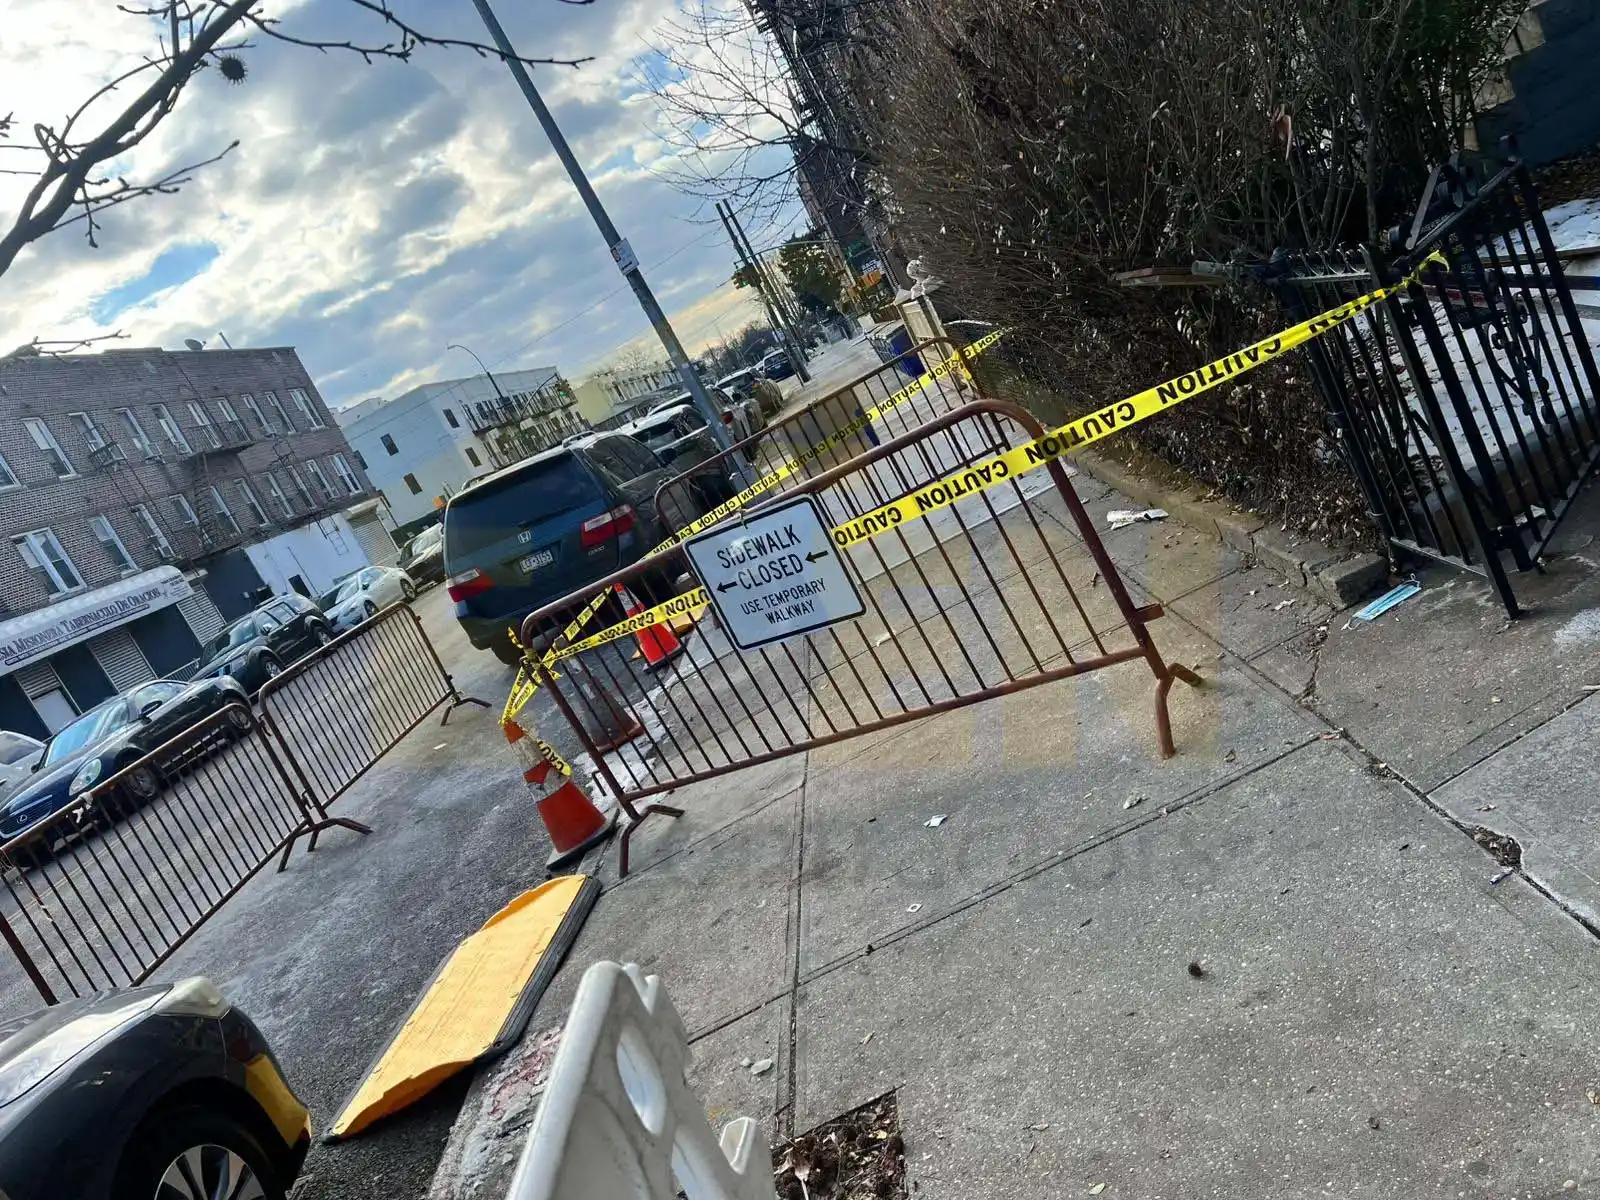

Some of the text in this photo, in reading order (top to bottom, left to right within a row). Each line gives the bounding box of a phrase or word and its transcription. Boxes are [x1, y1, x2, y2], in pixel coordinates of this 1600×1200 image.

[1024, 402, 1136, 465] CAUTION
[914, 459, 1010, 512] CAUTION
[717, 524, 801, 569] SIDEWALK
[738, 553, 804, 590] CLOSED
[741, 578, 826, 616] USE TEMPORARY
[765, 600, 816, 625] WALKWAY
